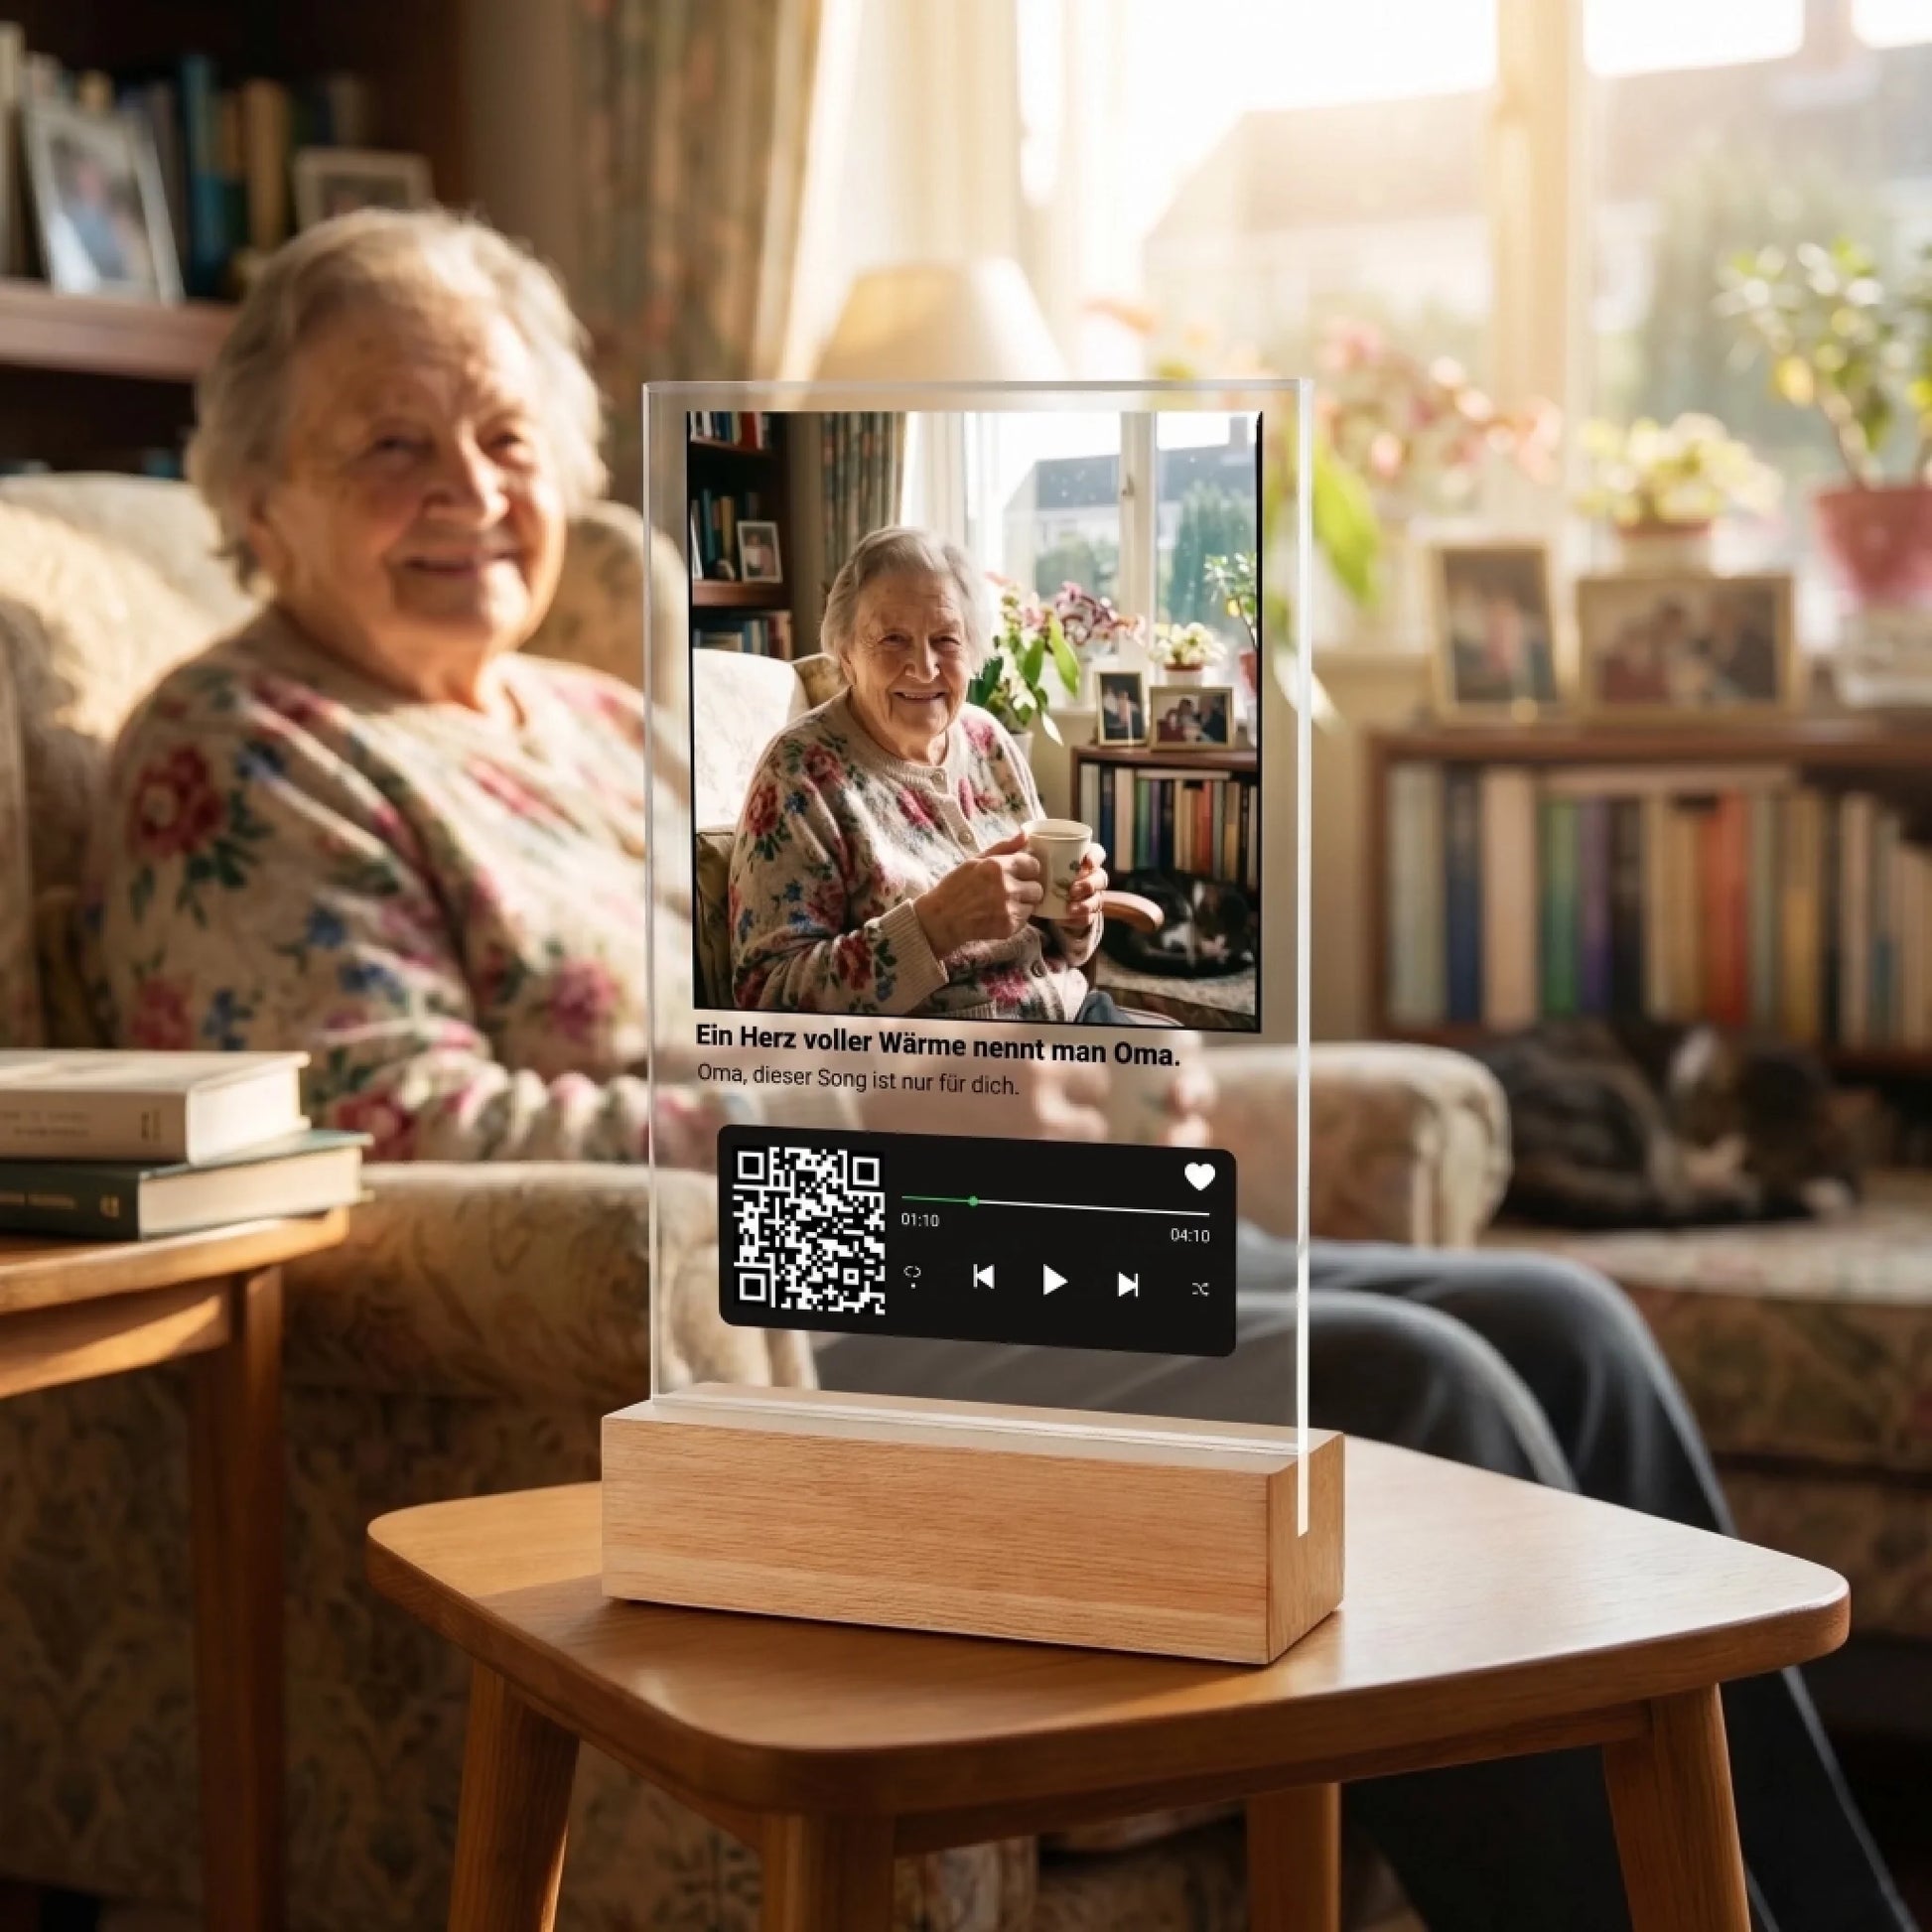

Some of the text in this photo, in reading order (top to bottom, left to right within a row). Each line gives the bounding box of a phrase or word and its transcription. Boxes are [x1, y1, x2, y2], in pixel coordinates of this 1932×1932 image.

[696, 1024, 1180, 1064] Ein Herz voller Wärme nennt man Oma.
[697, 1063, 1020, 1095] Oma, dieser Song ist nur für dich.
[900, 1212, 940, 1227] 01:10
[1170, 1227, 1210, 1243] 04:10
